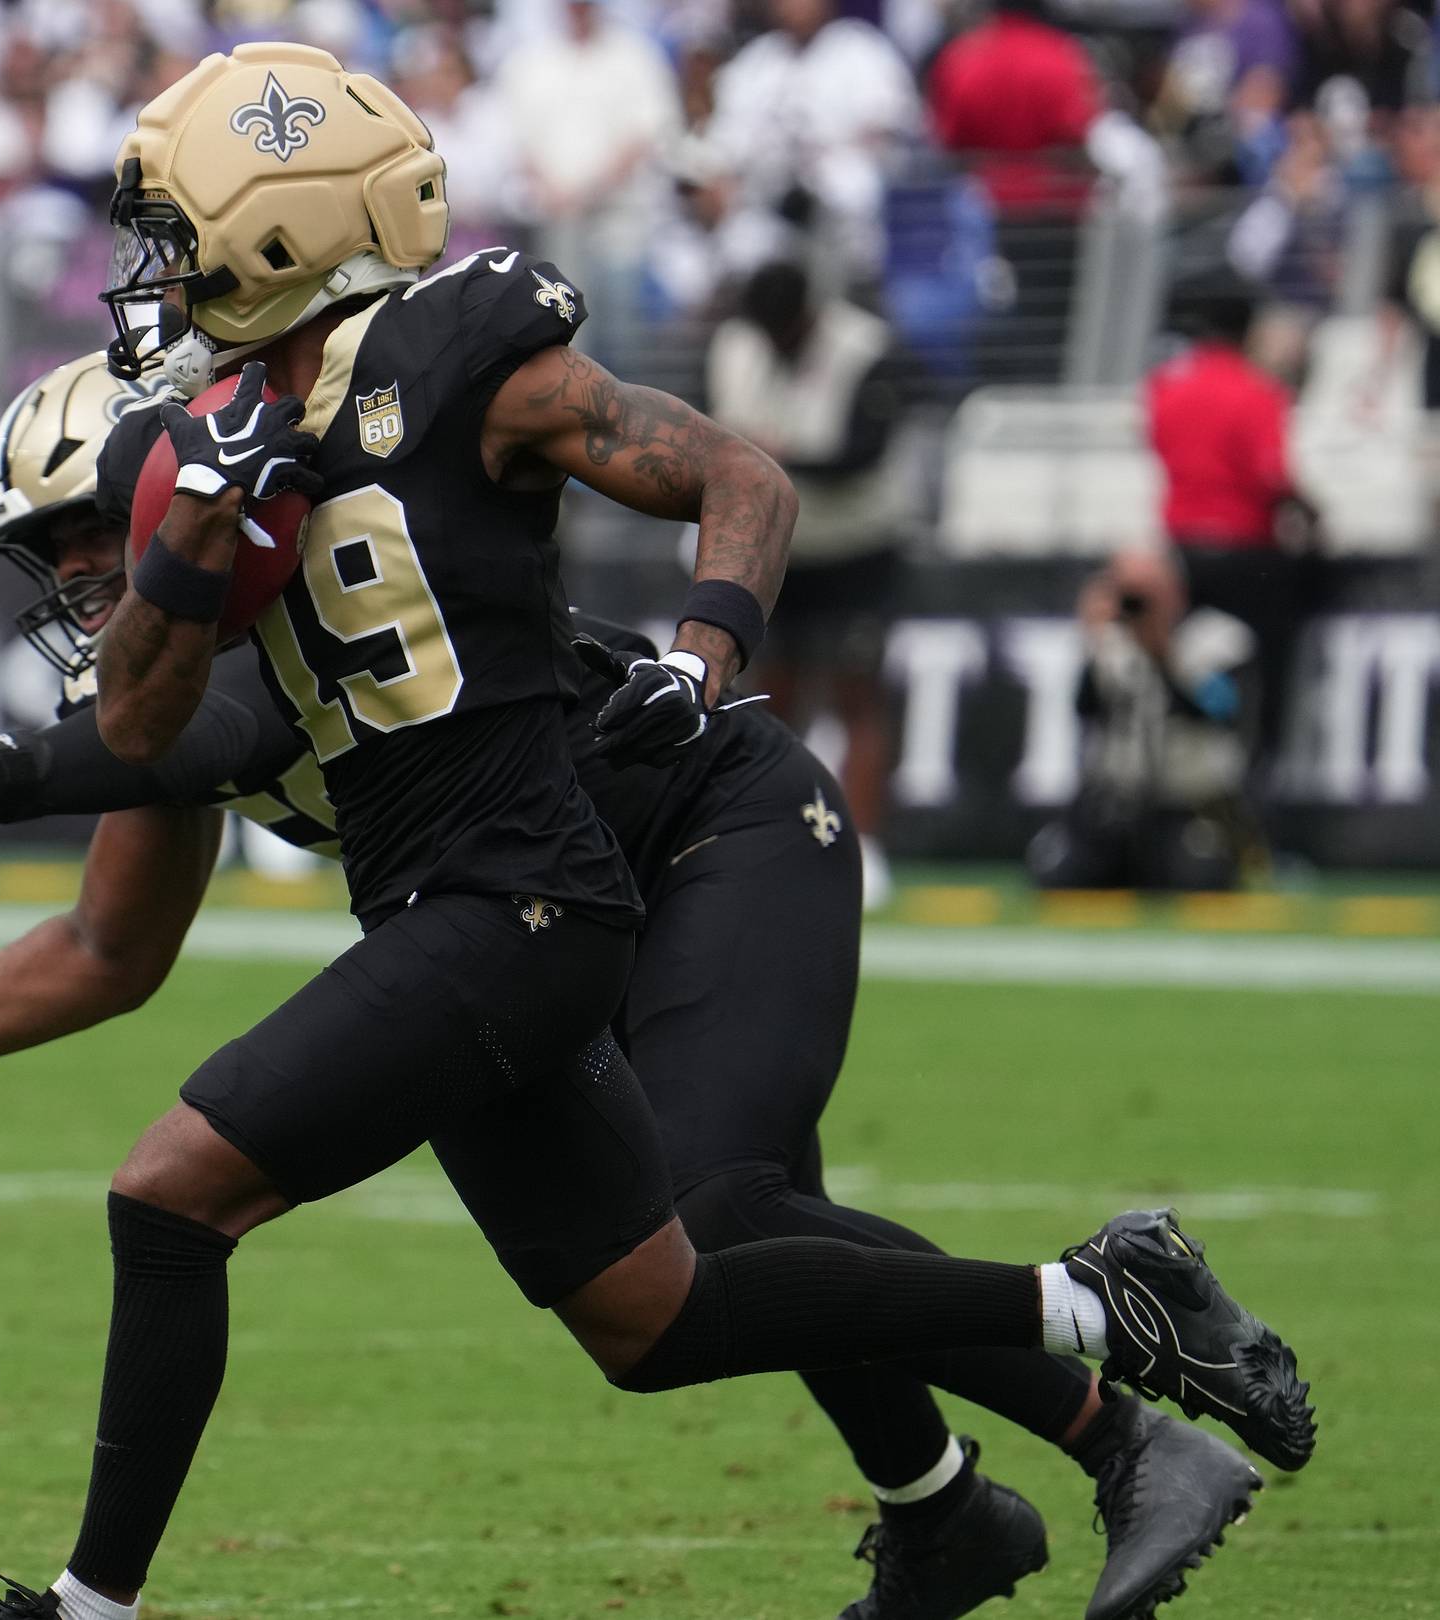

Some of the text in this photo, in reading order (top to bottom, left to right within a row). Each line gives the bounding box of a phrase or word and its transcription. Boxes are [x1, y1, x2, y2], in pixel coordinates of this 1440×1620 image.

[363, 392, 393, 411] EST. 1967
[365, 414, 399, 444] 60
[256, 483, 464, 765] 19
